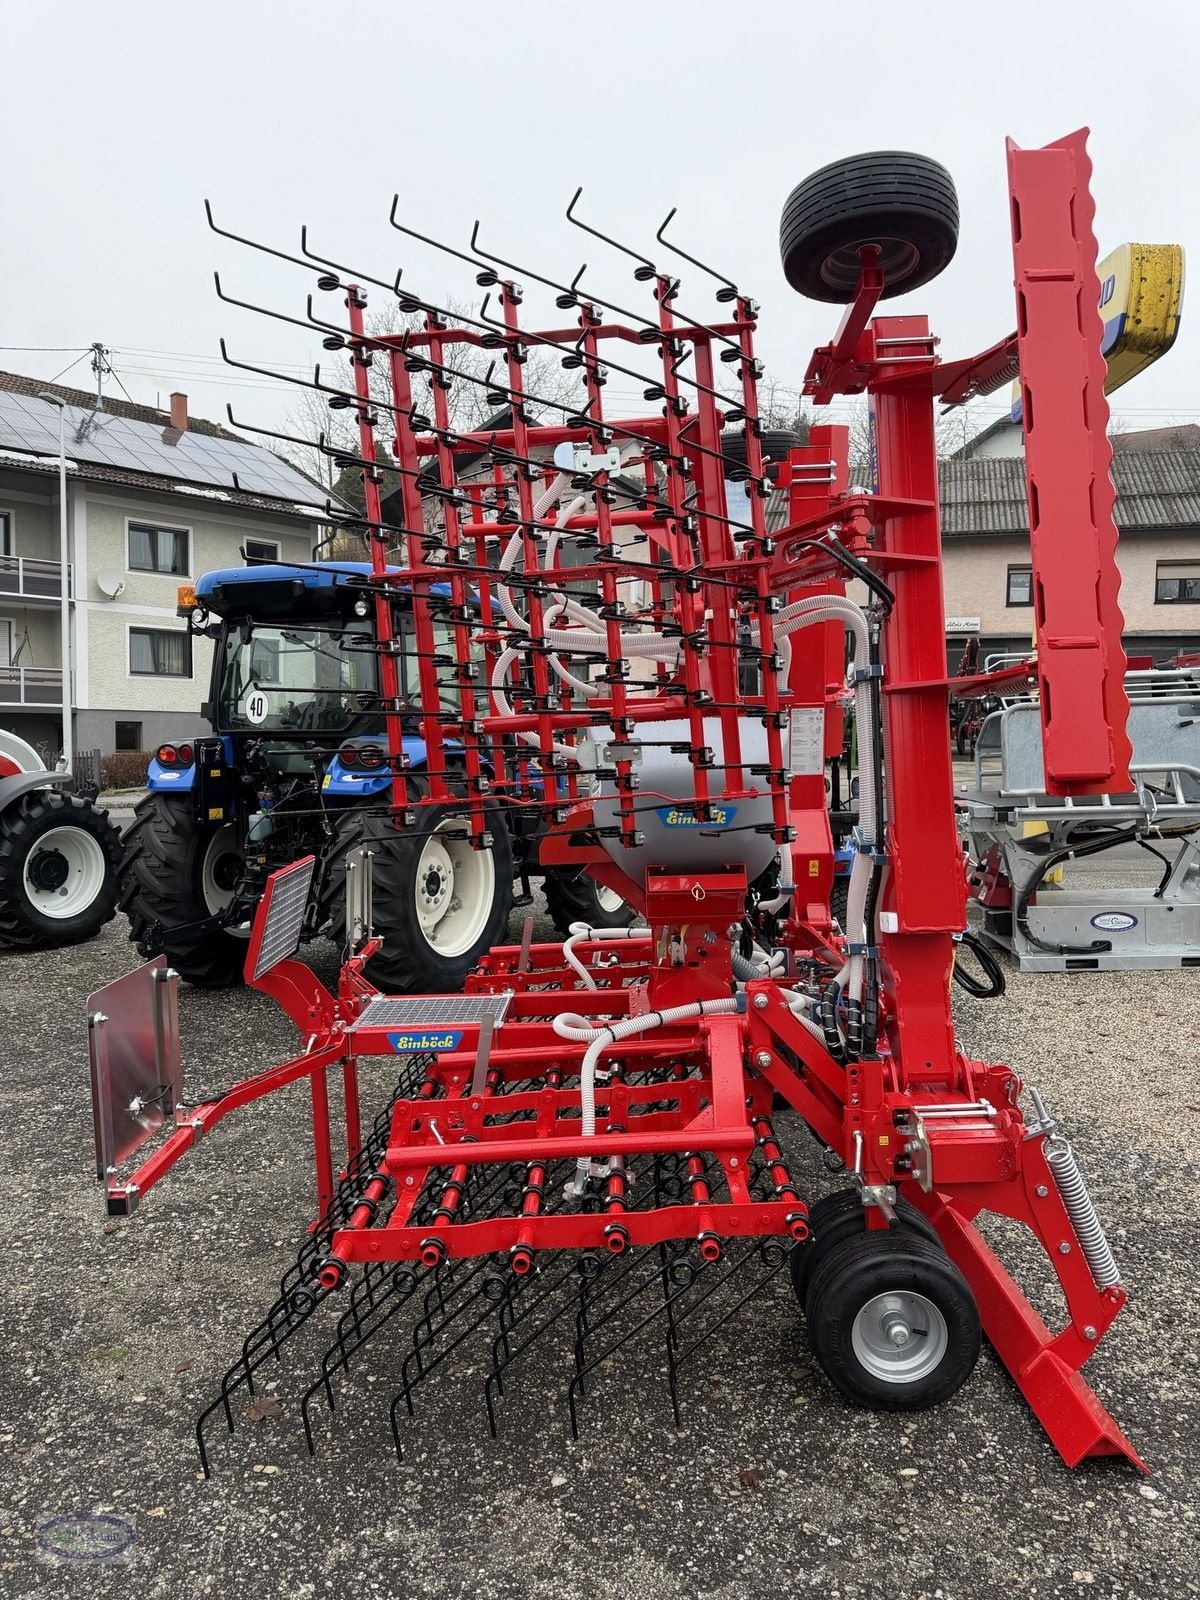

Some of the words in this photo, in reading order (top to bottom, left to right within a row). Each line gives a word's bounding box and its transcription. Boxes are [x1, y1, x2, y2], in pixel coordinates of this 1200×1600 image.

[250, 697, 263, 717] 40
[666, 811, 727, 825] Eink
[397, 1035, 454, 1049] Einböck
